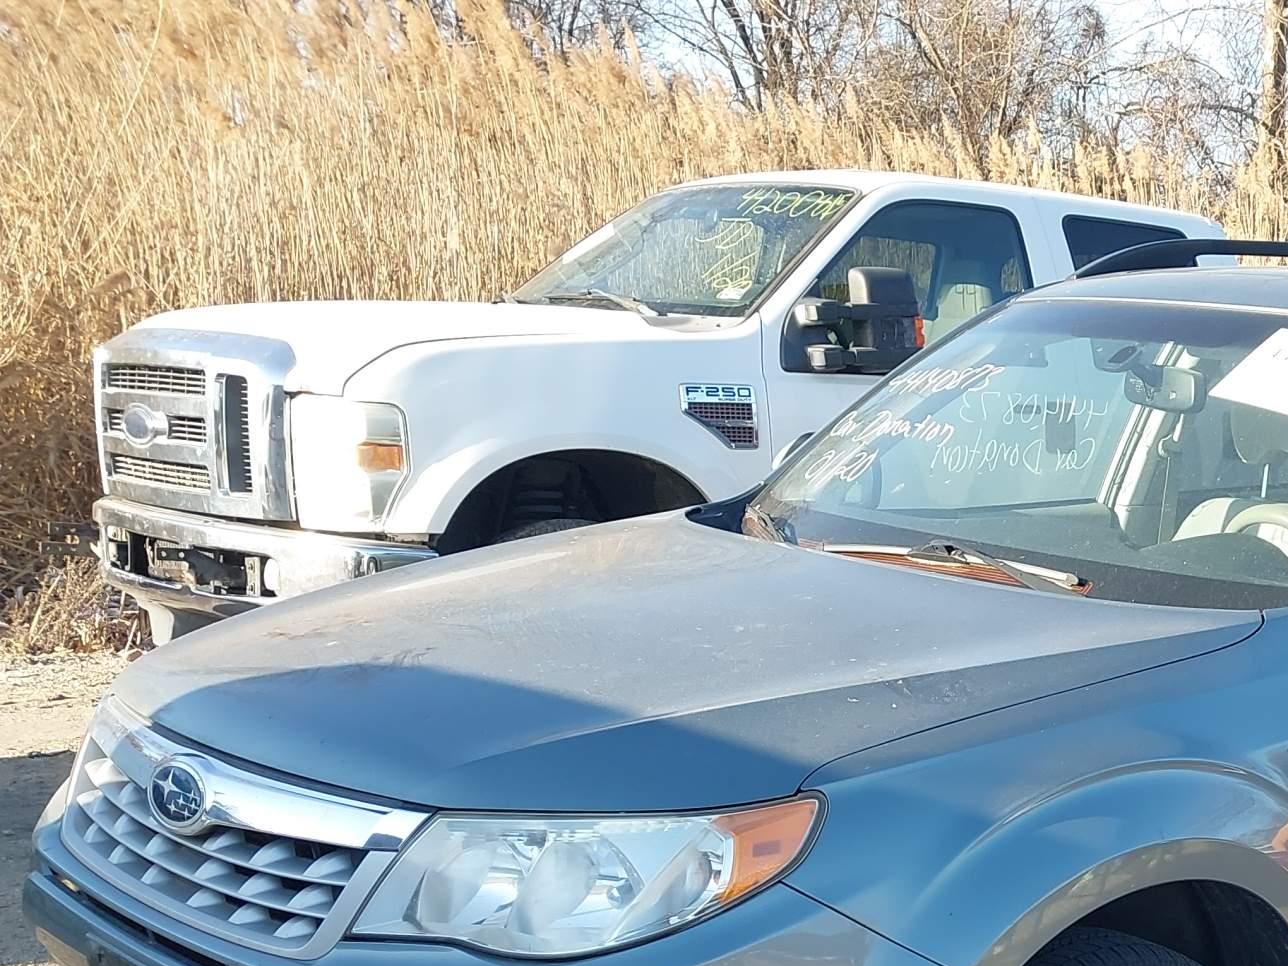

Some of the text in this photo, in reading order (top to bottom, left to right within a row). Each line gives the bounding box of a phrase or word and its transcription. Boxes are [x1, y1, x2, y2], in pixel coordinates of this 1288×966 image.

[685, 386, 751, 397] F-250
[889, 364, 1005, 396] 44140873
[830, 410, 862, 438] Car
